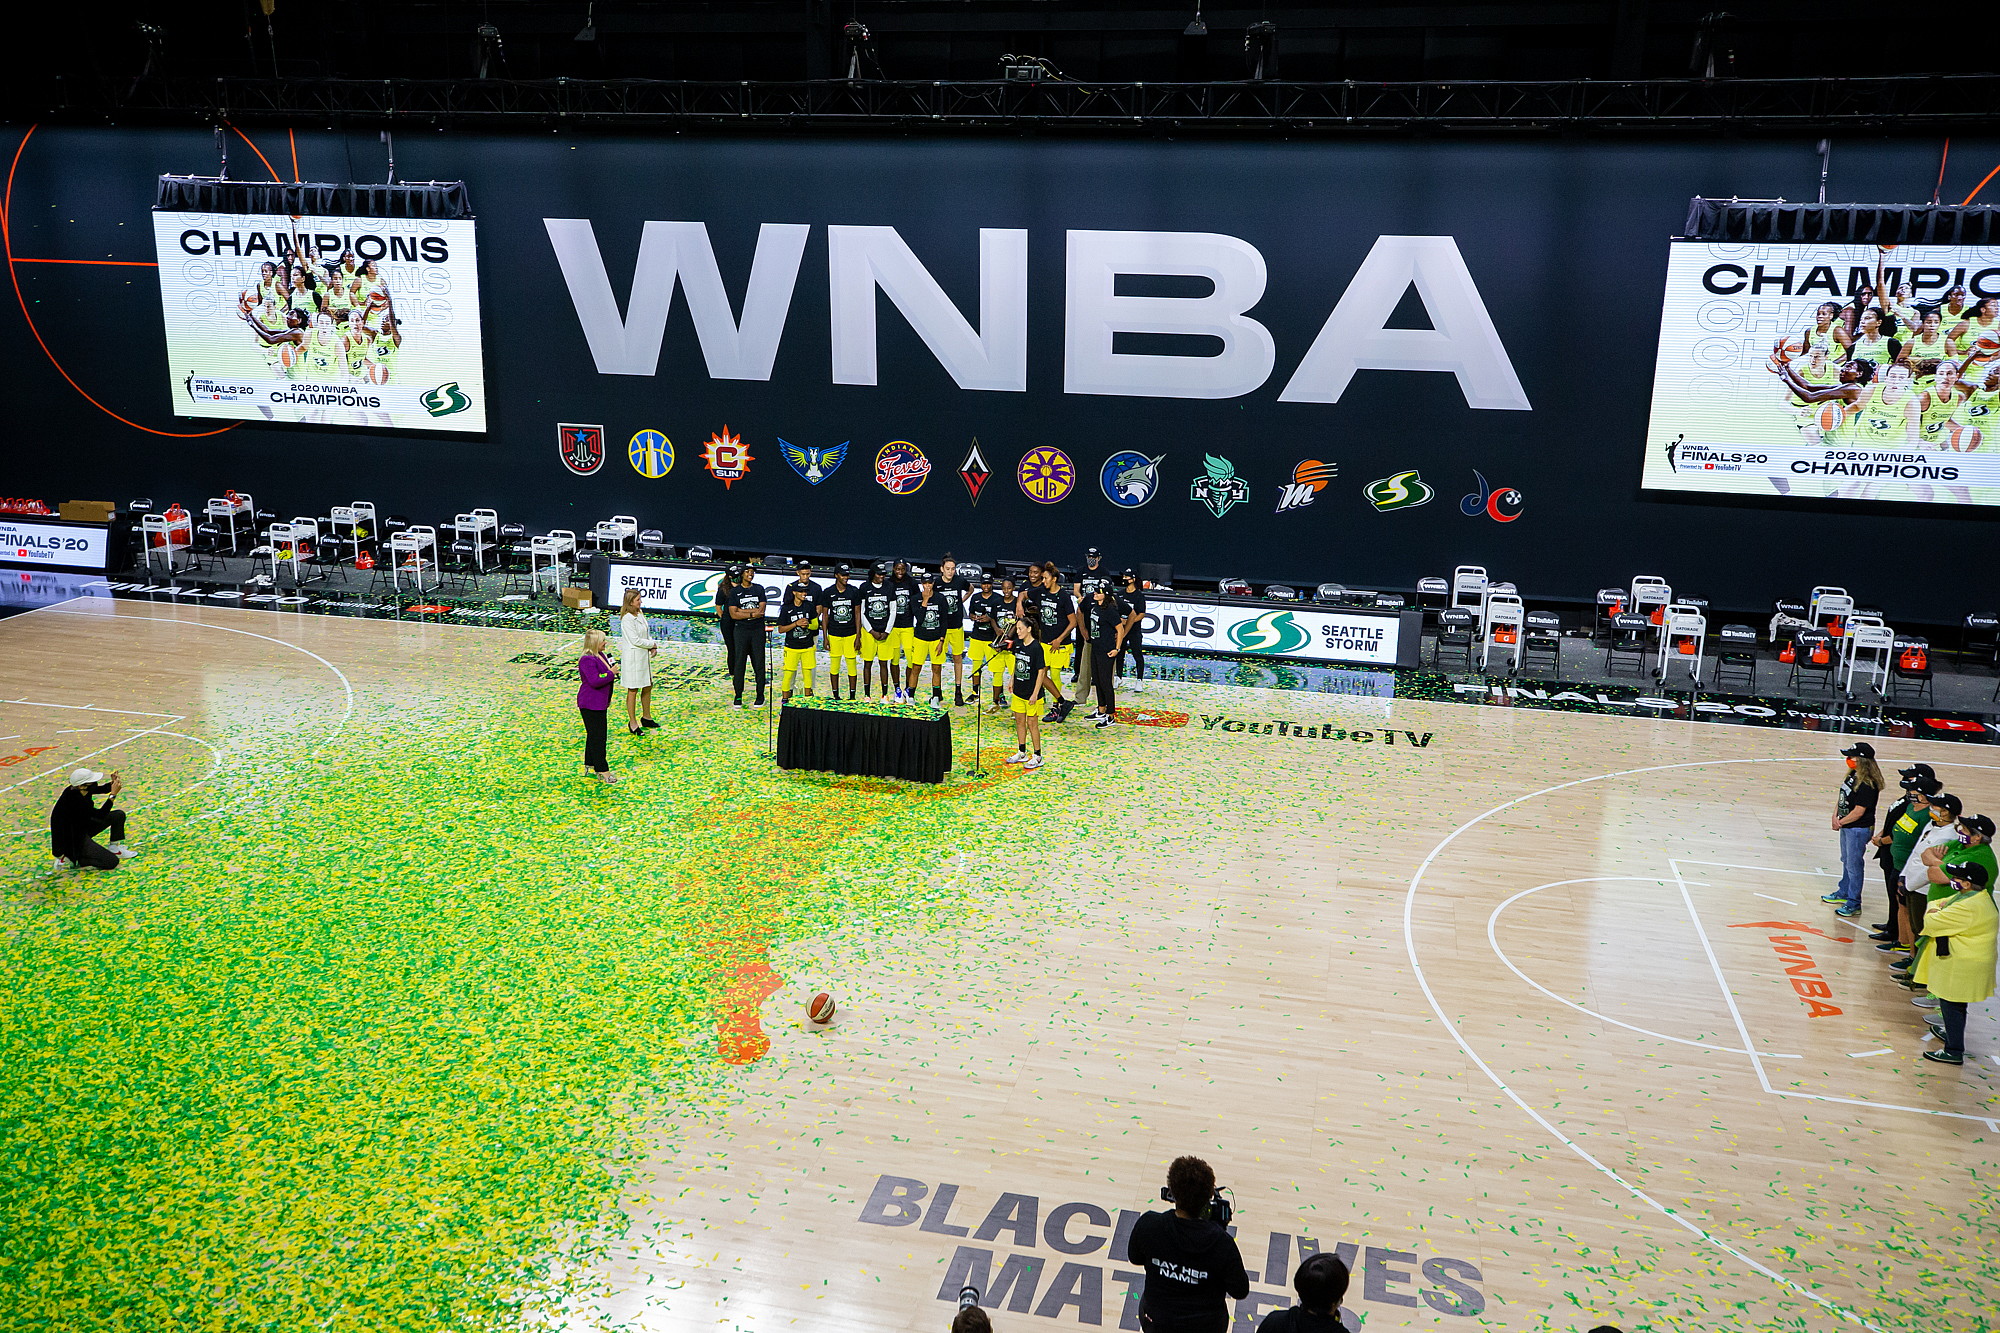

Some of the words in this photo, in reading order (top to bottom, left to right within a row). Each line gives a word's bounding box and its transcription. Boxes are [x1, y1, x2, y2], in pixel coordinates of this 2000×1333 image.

[180, 229, 449, 263] CHAMPIONS
[543, 218, 1533, 410] WNBA
[195, 385, 254, 395] FINALS'20
[291, 384, 318, 392] 2020
[322, 386, 358, 394] WNBA
[270, 392, 381, 408] CHAMPIONS
[715, 446, 738, 468] C
[881, 444, 920, 459] INDIANA
[1681, 452, 1768, 463] FINALS'20
[1825, 451, 1869, 461] 2020
[1873, 453, 1927, 463] WNBA
[569, 456, 597, 468] DREAM
[876, 454, 931, 482] Fever
[715, 470, 739, 479] SUN
[1790, 461, 1959, 480] CHAMPIONS
[621, 575, 672, 588] SEATTLE
[1322, 625, 1384, 639] SEATTLE
[1325, 638, 1378, 651] STORM
[1786, 709, 1883, 725] Presented
[1888, 717, 1913, 729] by
[1768, 936, 1844, 1019] WNBA
[1159, 1267, 1199, 1285] NAME
[1182, 1265, 1208, 1279] HER
[1227, 1225, 1487, 1317] IVES
